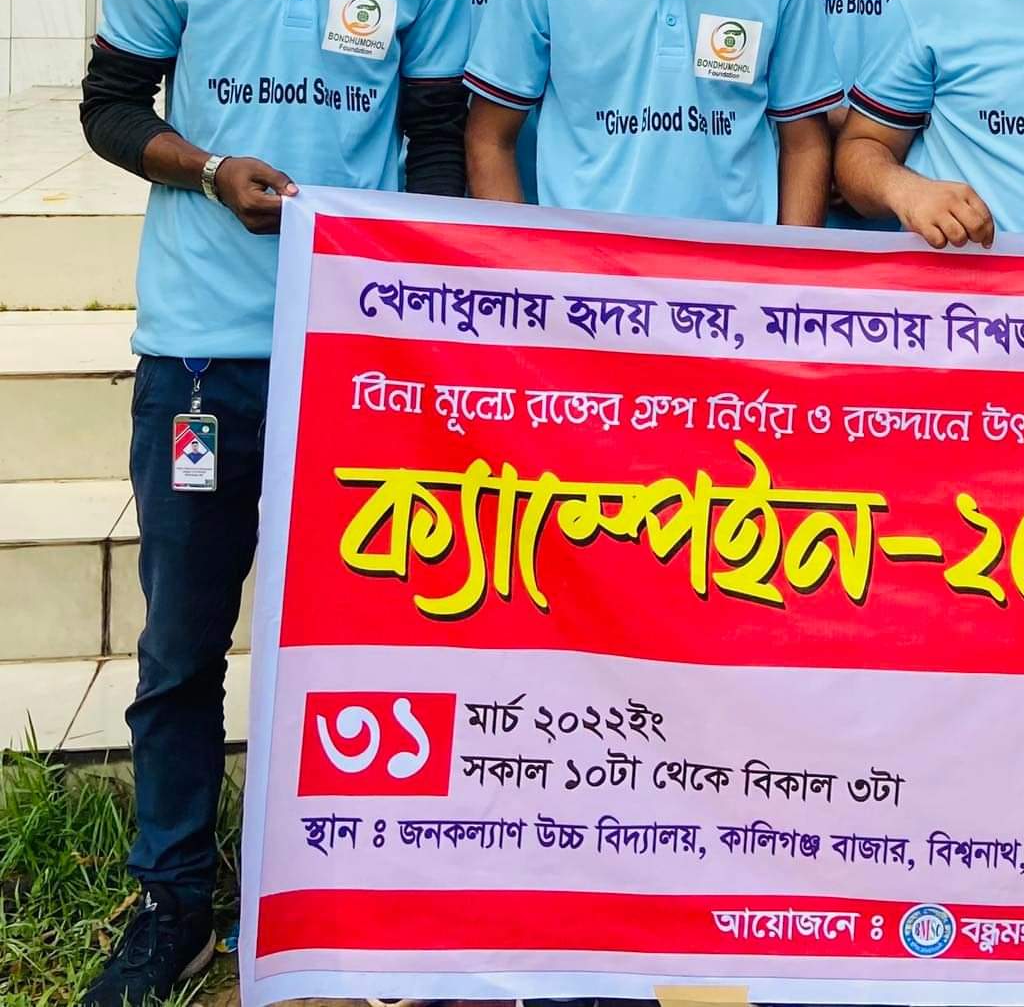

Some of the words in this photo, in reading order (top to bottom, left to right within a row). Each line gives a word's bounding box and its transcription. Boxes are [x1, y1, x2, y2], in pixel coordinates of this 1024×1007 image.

[328, 31, 385, 50] BONDHUMOHOL
[697, 58, 751, 74] BONDHUMOHOL
[208, 78, 253, 105] "Give
[258, 77, 308, 105] Blood
[346, 85, 377, 113] life"
[596, 109, 638, 135] "Give
[712, 110, 736, 136] life"
[360, 279, 553, 337] খেলাধুলায়
[563, 296, 657, 339] হৃদয়
[666, 301, 744, 350] জয়,
[761, 303, 932, 351] মানবতায়
[352, 370, 425, 414] বিনা
[434, 384, 517, 435] মূল্যে
[525, 389, 623, 431] রক্তের
[631, 394, 697, 430] গ্রুপ
[706, 388, 797, 439] নির্ণয়
[807, 405, 831, 434] ও
[843, 406, 973, 443] রক্তদানে
[316, 697, 431, 780] ৩১
[465, 693, 527, 735] মার্চ
[534, 698, 666, 744] ২০২২ইং
[460, 755, 553, 789] সকাল
[565, 748, 642, 790] ১০টা
[653, 759, 733, 793] থেকে
[741, 759, 838, 802] বিকাল
[848, 767, 905, 806] ৩টা
[301, 813, 363, 856] স্থান
[398, 817, 528, 849] জনকল্যাণ
[534, 813, 588, 849] উচ্চ
[595, 815, 706, 859] বিদ্যালয়,
[717, 820, 821, 859] কালিগঞ্জ
[830, 833, 915, 870] বাজার,
[711, 907, 861, 941] আয়োজনে
